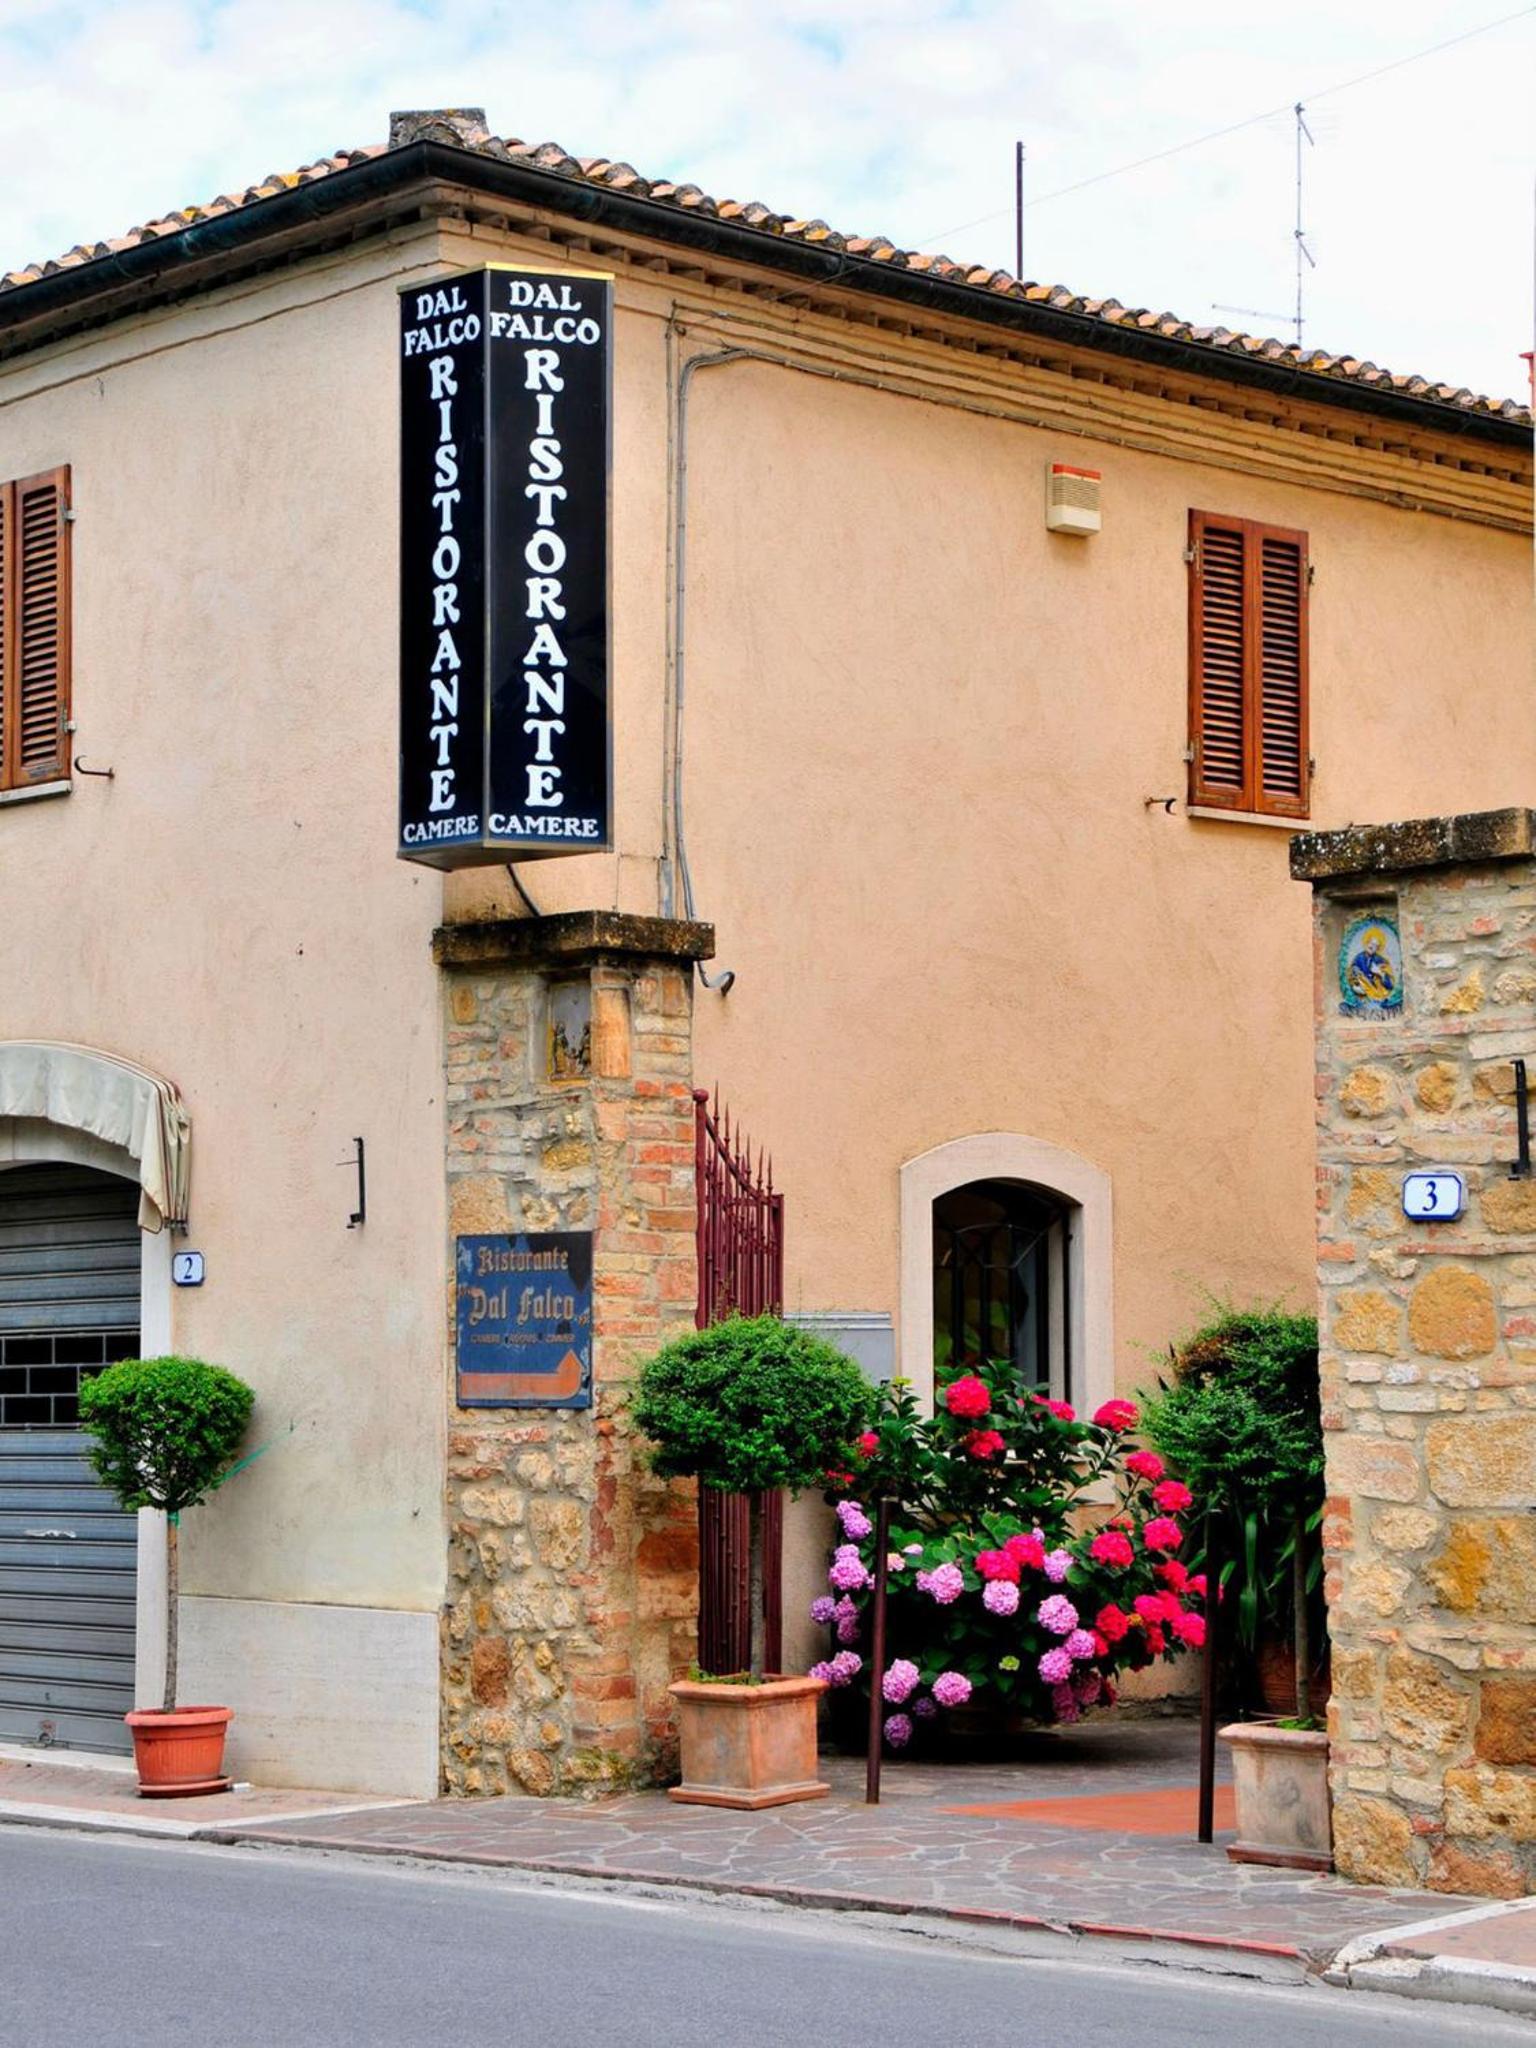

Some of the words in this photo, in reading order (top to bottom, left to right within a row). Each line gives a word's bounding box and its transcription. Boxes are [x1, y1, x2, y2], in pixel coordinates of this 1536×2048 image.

[416, 286, 468, 320] DAL
[508, 280, 582, 311] DAL
[404, 313, 481, 357] FALCO
[489, 311, 601, 345] FALCO
[428, 355, 462, 812] RISTORANTE
[522, 348, 569, 807] RISTORANTE
[403, 815, 480, 843] CAMERE
[488, 813, 600, 838] CAMERE
[1422, 1180, 1438, 1212] 3
[183, 1256, 194, 1280] 2
[478, 1245, 569, 1277] Ristorante
